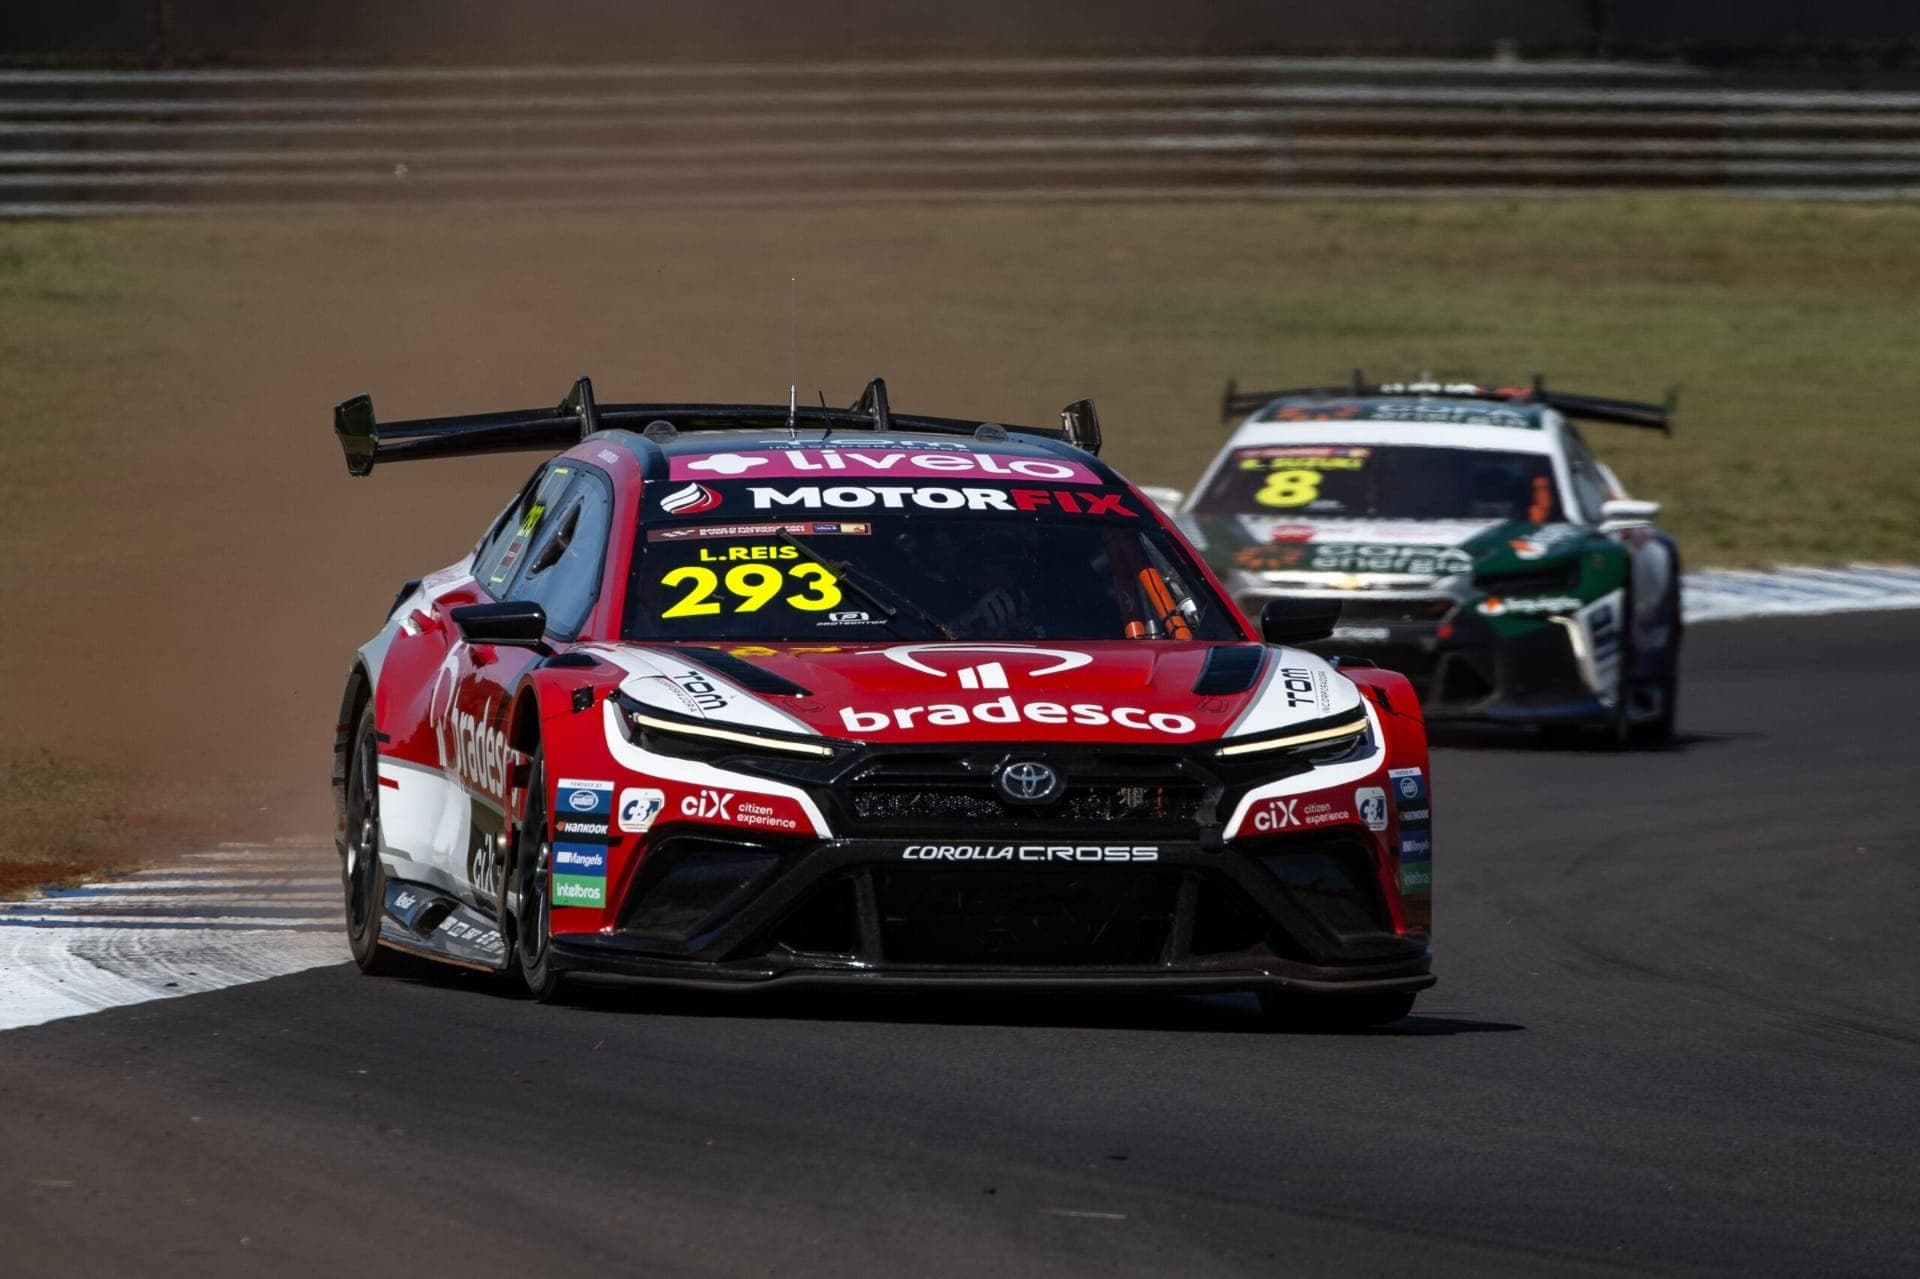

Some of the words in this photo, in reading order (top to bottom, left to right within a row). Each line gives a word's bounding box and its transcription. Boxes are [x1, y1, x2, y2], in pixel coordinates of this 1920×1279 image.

[1255, 470, 1323, 508] 8
[746, 486, 1139, 517] MOTORFIX
[700, 546, 799, 561] L.REIS
[661, 563, 842, 619] 293
[839, 695, 1196, 734] bradesco
[738, 803, 773, 815] citizen
[1304, 802, 1331, 814] citizen
[737, 813, 796, 829] experience
[1305, 810, 1349, 825] experience
[902, 846, 1014, 861] COROLLA
[1019, 846, 1158, 862] CROSS
[557, 882, 600, 899] intelbras
